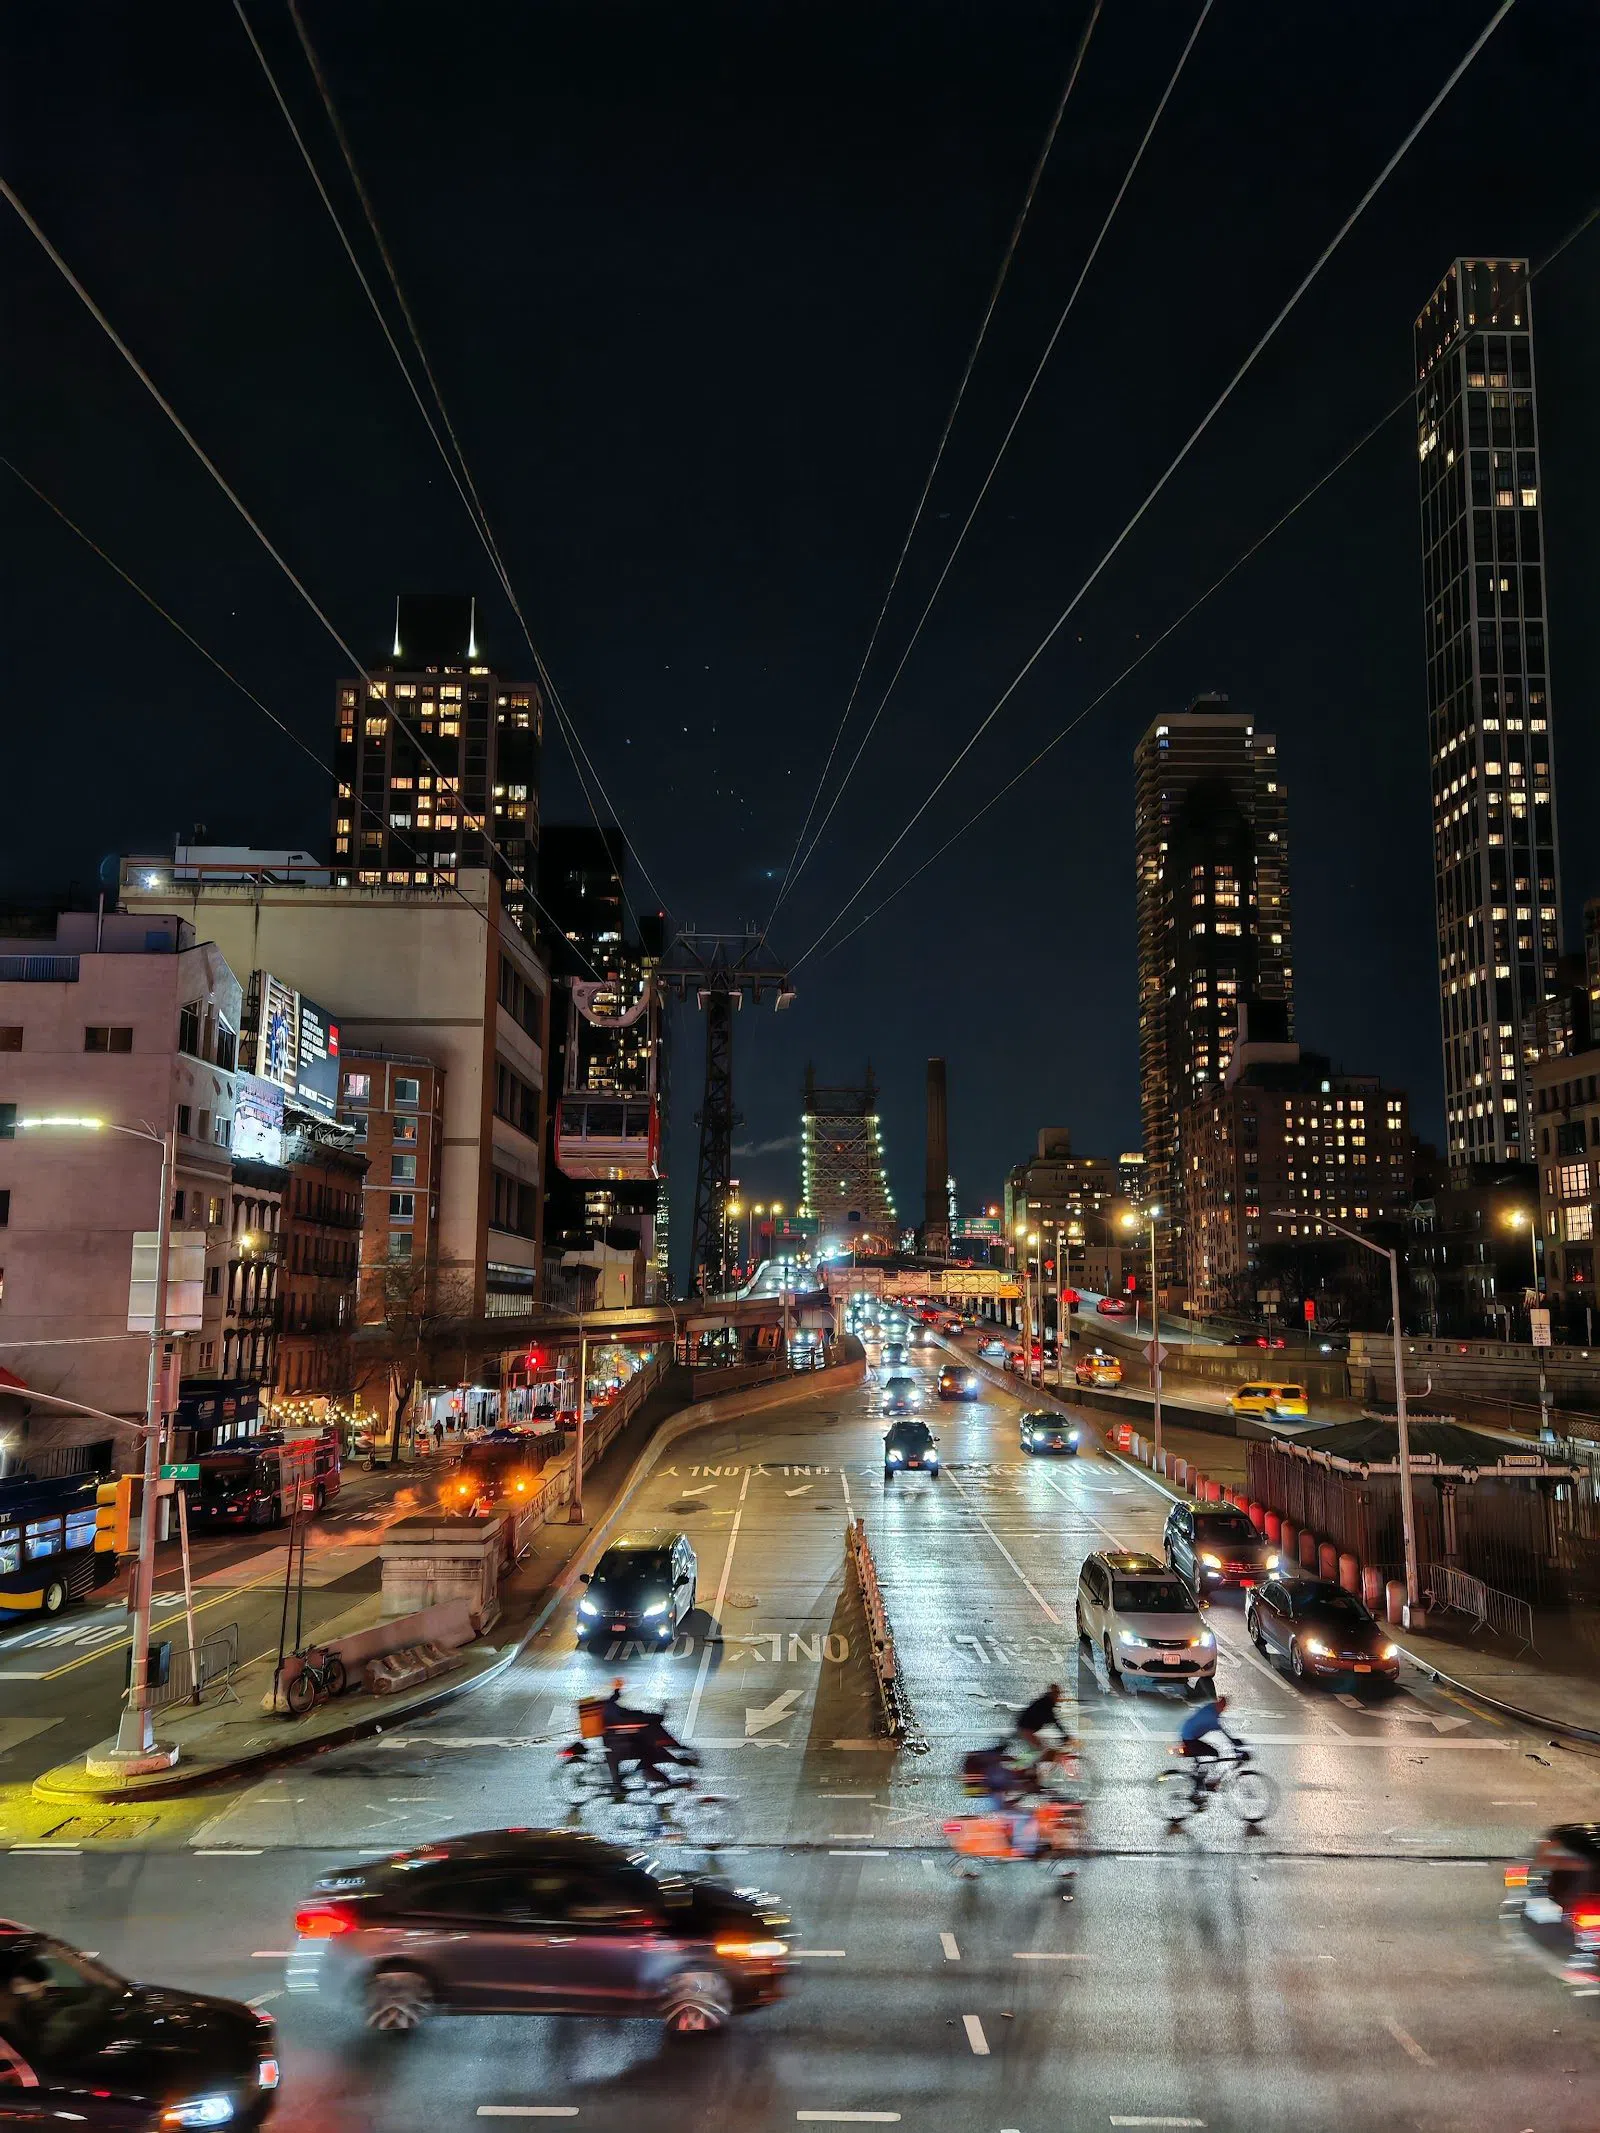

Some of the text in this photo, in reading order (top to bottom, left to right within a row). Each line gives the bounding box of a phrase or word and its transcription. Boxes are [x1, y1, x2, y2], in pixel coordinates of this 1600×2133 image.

[169, 1467, 178, 1478] 2
[657, 1466, 741, 1477] ONLY
[728, 1633, 850, 1663] ONLY
